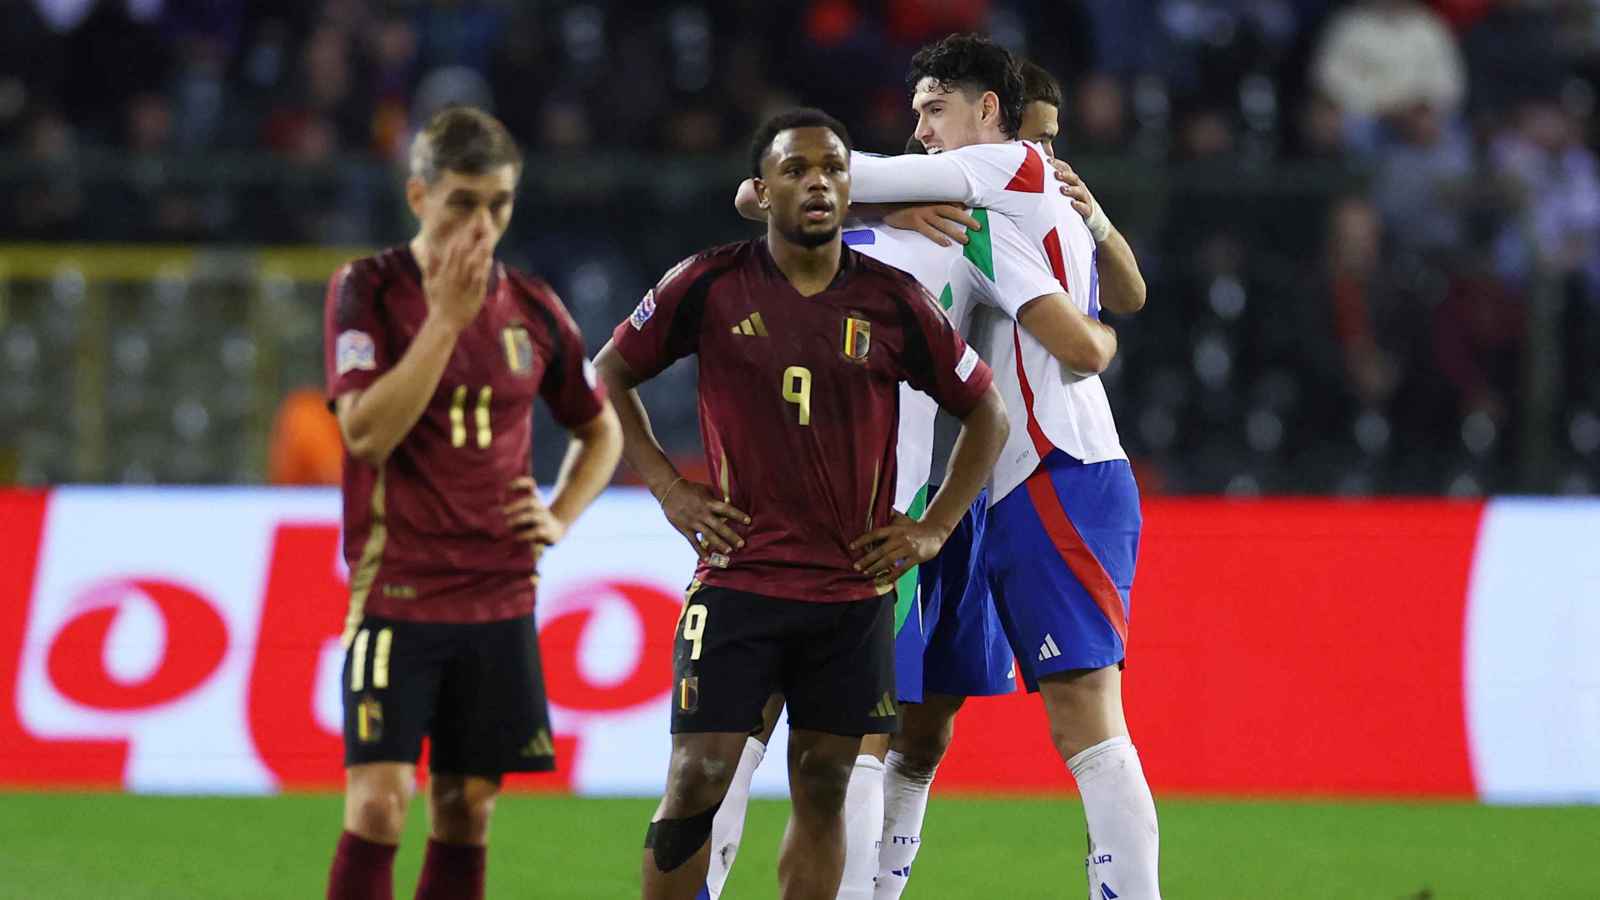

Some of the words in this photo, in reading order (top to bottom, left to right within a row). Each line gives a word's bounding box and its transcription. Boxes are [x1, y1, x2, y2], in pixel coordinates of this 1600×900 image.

[449, 385, 493, 449] 11
[782, 366, 812, 426] 9
[350, 627, 393, 692] 11
[683, 604, 709, 660] 9
